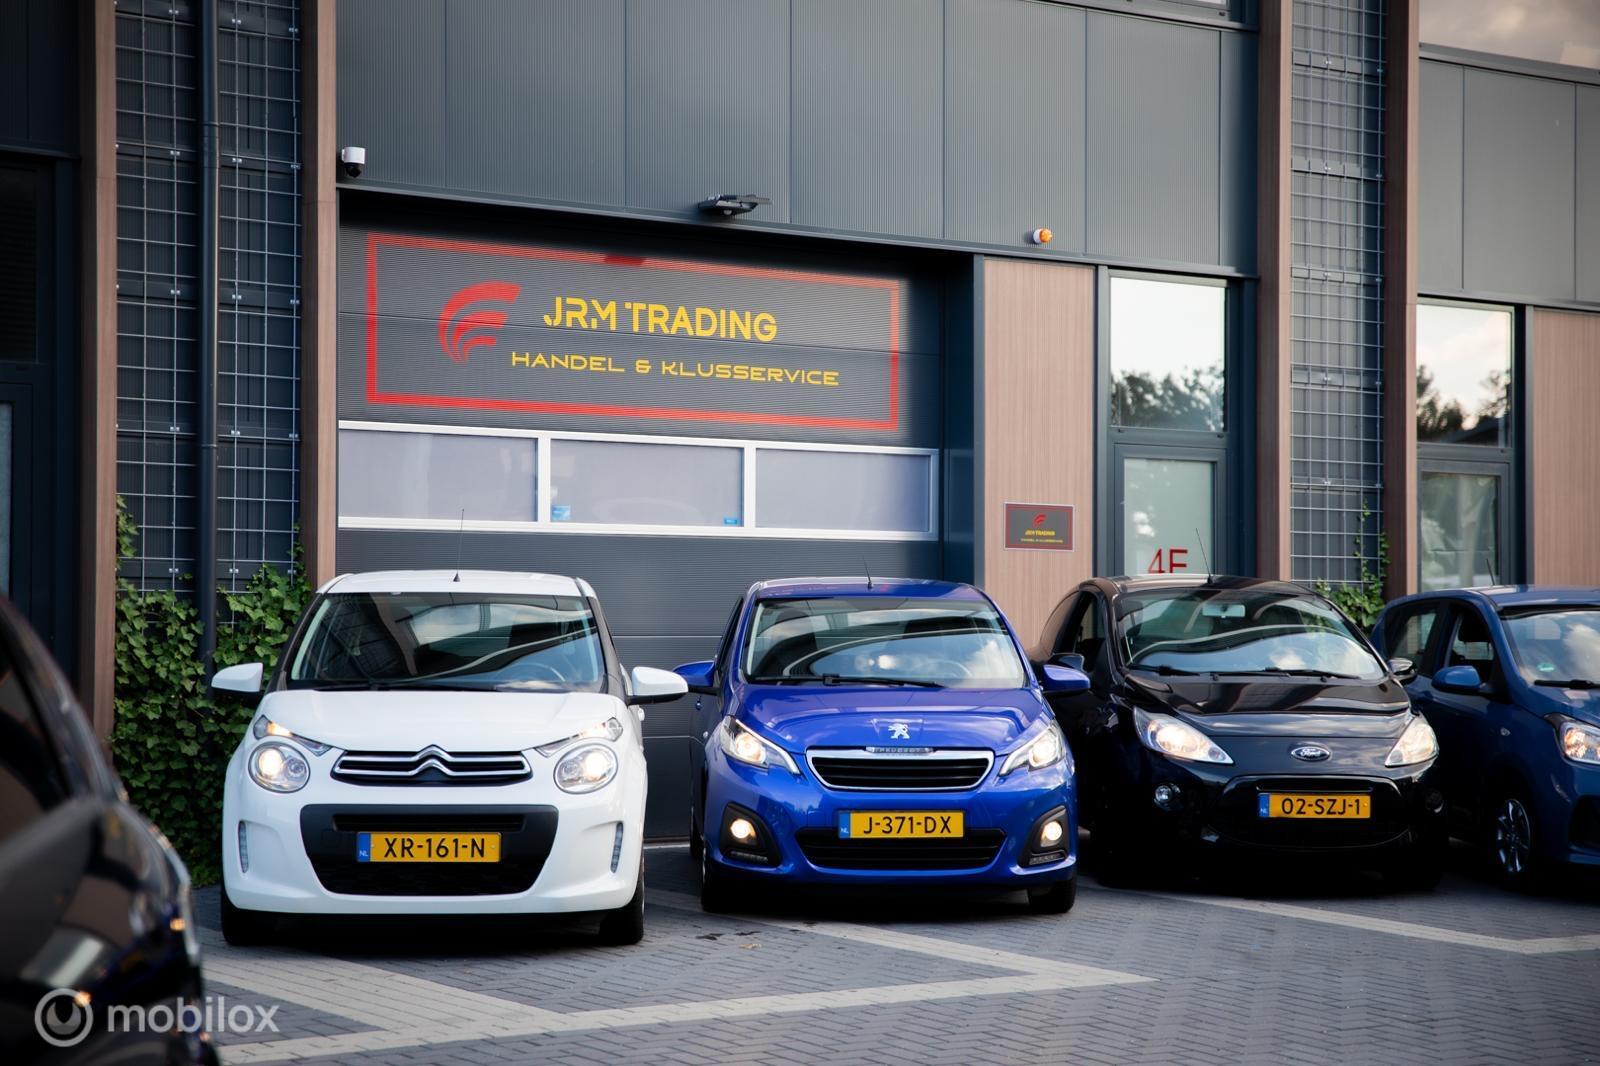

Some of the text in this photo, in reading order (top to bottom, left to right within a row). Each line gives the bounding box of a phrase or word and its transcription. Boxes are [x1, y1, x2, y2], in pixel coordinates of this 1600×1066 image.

[543, 296, 778, 341] JRM TRADING
[511, 352, 840, 386] HANDEL & KLUSSERVICE
[1281, 798, 1360, 815] 02-SZJ-1
[863, 816, 952, 834] J-371-DX
[383, 837, 485, 858] XR-161-N
